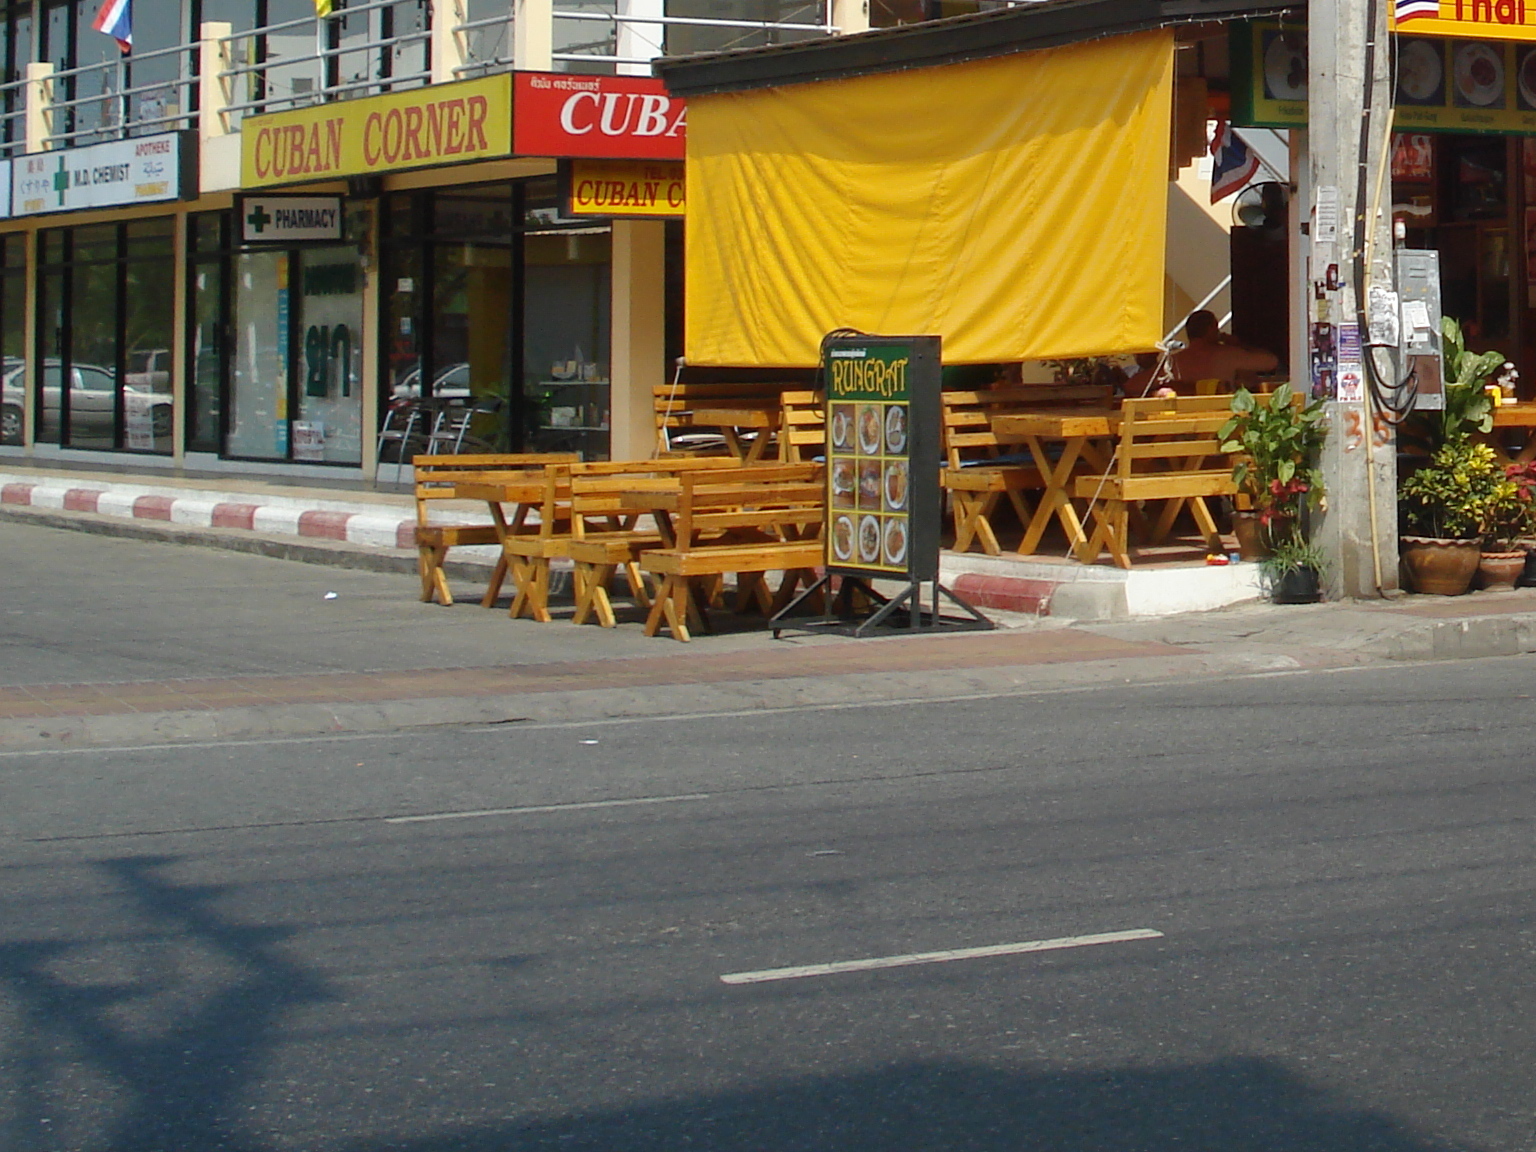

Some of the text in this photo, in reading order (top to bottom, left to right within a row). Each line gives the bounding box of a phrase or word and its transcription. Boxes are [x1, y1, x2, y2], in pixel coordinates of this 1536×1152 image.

[255, 95, 488, 179] CUBAN CORNER
[92, 163, 130, 184] CHEMIST
[577, 180, 660, 207] CUBAN
[275, 209, 336, 229] PHARMACY
[305, 323, 351, 397] ยา
[832, 357, 908, 397] RUNGRAT
